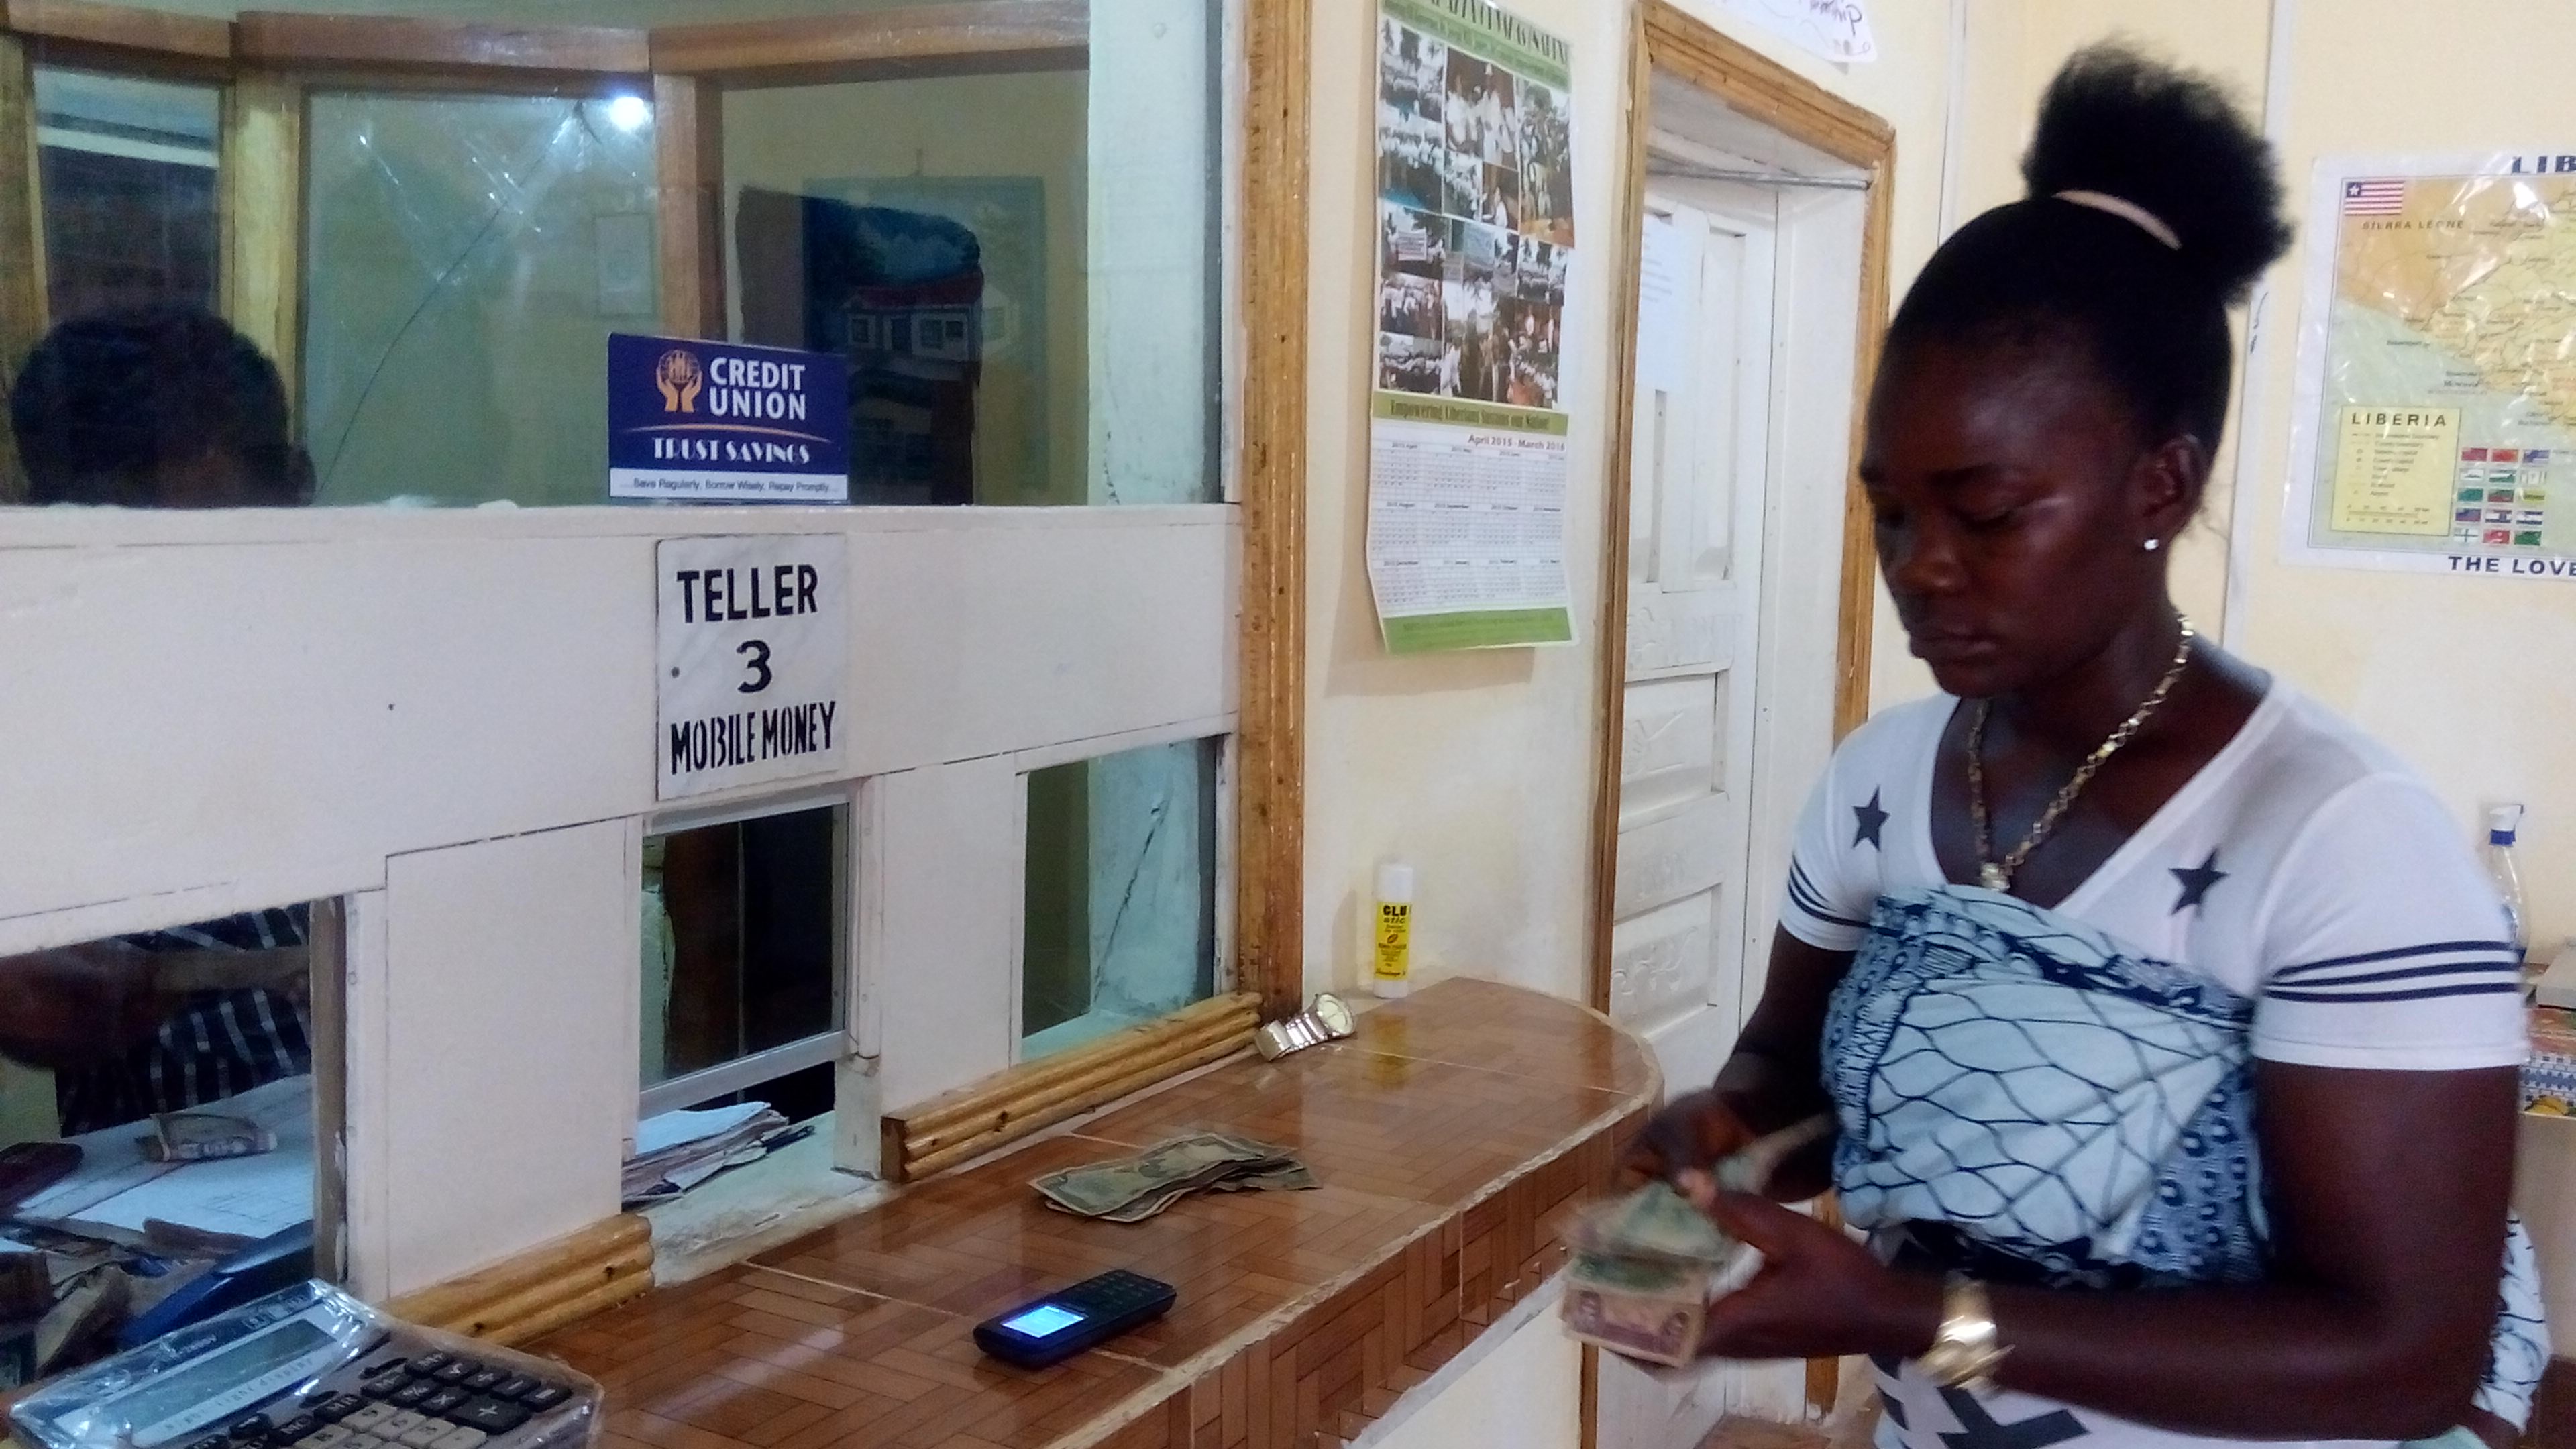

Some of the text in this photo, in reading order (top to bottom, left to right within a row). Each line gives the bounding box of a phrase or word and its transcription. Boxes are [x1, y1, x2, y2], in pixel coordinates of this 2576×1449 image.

[710, 356, 806, 391] CREDIT
[710, 387, 806, 421] UNION
[2351, 413, 2446, 427] LIBERIA
[653, 437, 810, 465] TRUST SAVINGS
[1468, 435, 1490, 447] April
[1491, 437, 1513, 447] 2015
[1518, 439, 1544, 449] March
[2449, 556, 2500, 572] THE
[676, 564, 818, 623] TELLER
[736, 639, 772, 693] 3
[671, 700, 836, 775] MOBILE MONEY
